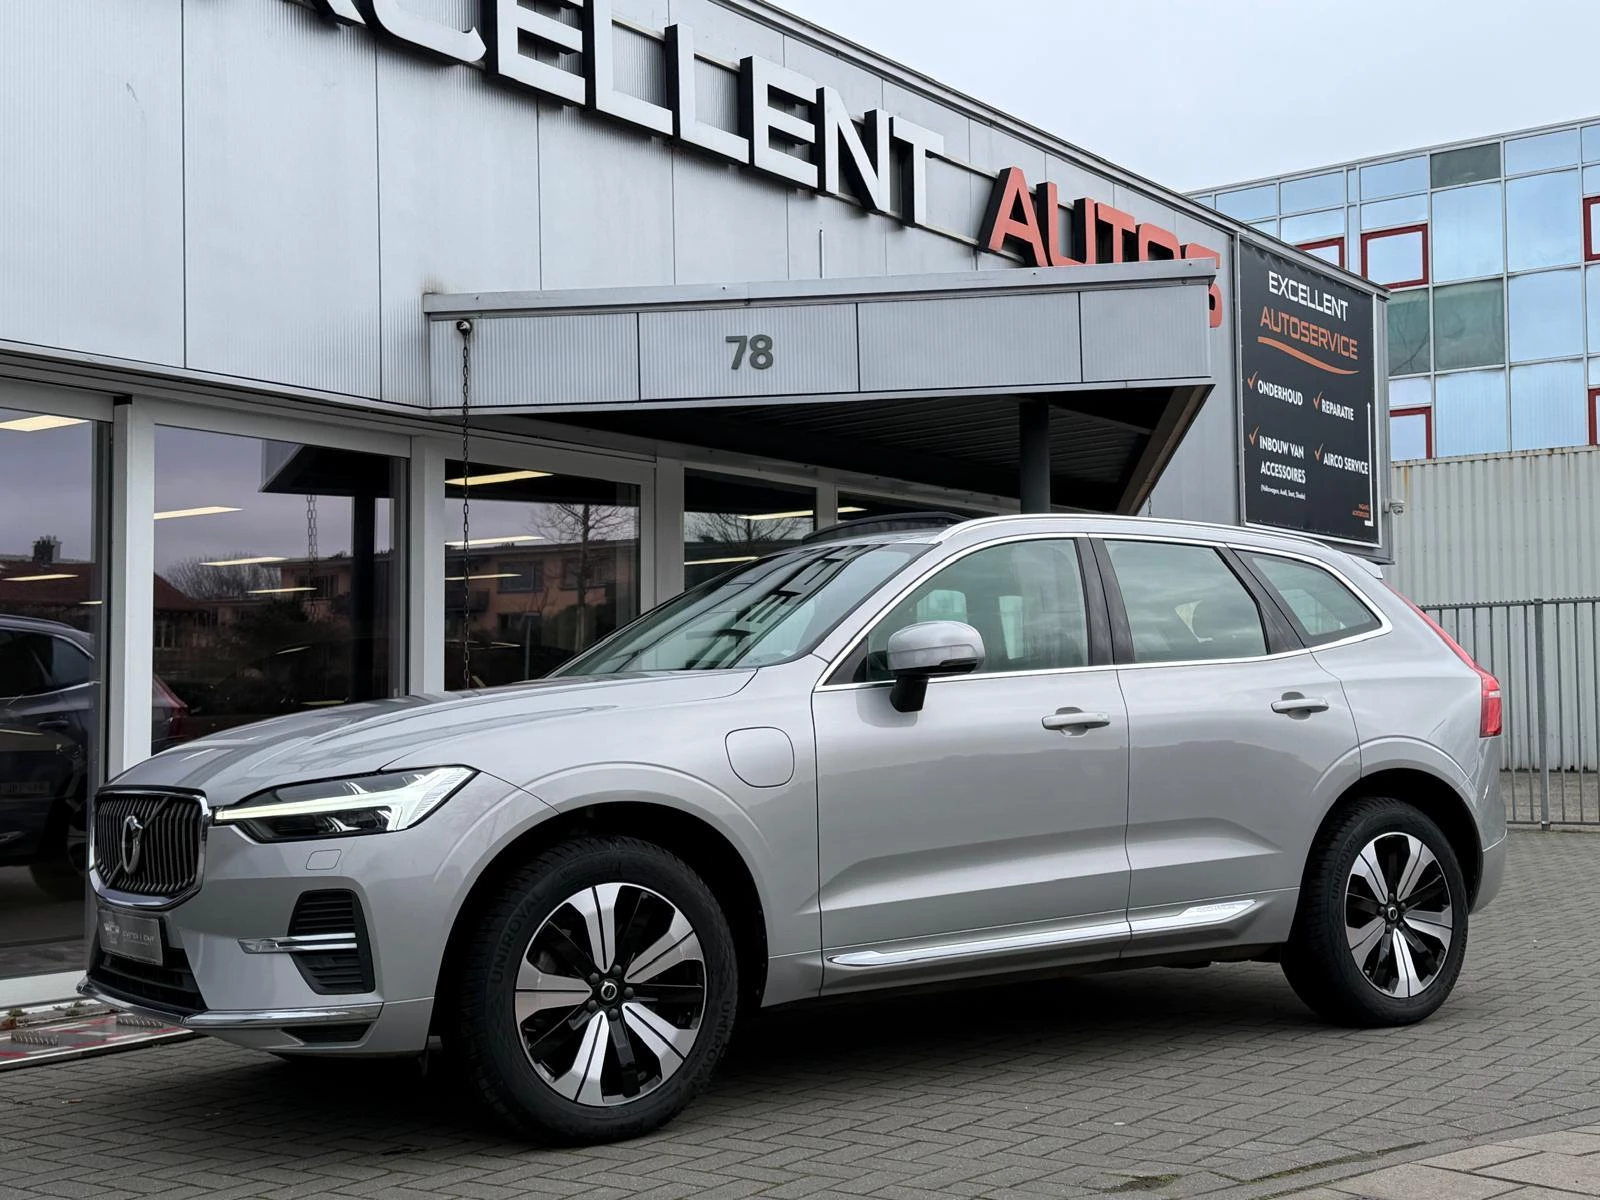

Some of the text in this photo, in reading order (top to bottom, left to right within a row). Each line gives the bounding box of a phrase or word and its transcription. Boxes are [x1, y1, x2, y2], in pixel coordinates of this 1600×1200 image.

[311, 0, 944, 226] ELLENT
[1268, 270, 1349, 322] EXCELLENT
[1260, 305, 1359, 361] AUTOSERVICE
[725, 334, 774, 370] 78
[1257, 379, 1304, 406] ONDERHOUD
[1321, 399, 1355, 421] REPARATIE
[1259, 435, 1305, 459] INBOUW VAN
[1260, 460, 1306, 484] ACCESSOIRES
[1323, 452, 1369, 475] AIRCO SERVICE
[490, 891, 547, 985] UNIROYAL
